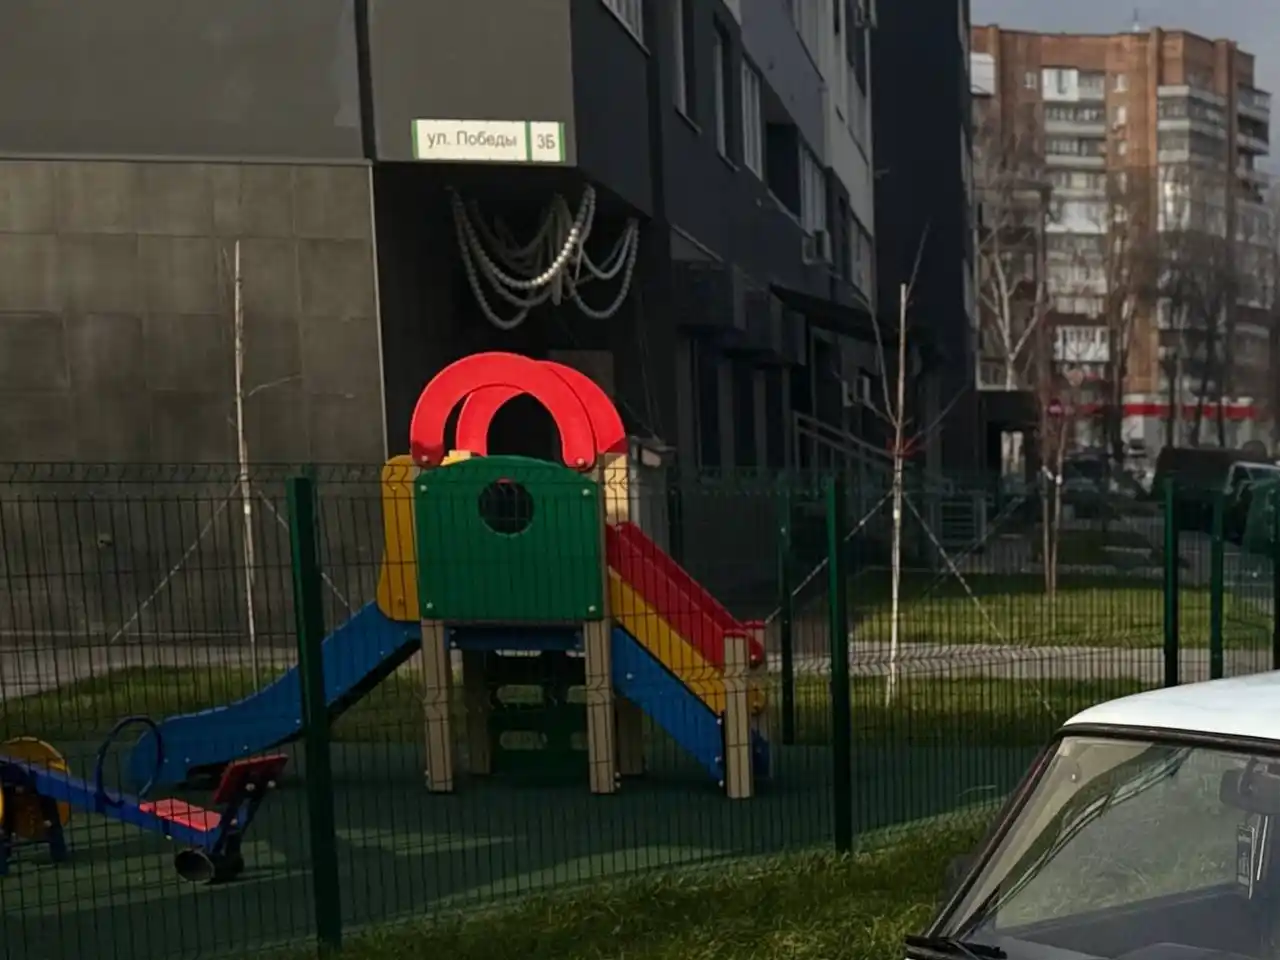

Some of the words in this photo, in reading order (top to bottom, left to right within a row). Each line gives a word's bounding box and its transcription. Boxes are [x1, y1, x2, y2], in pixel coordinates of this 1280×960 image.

[427, 132, 450, 149] ул.
[456, 130, 518, 148] Победы
[536, 133, 556, 150] 3Б
